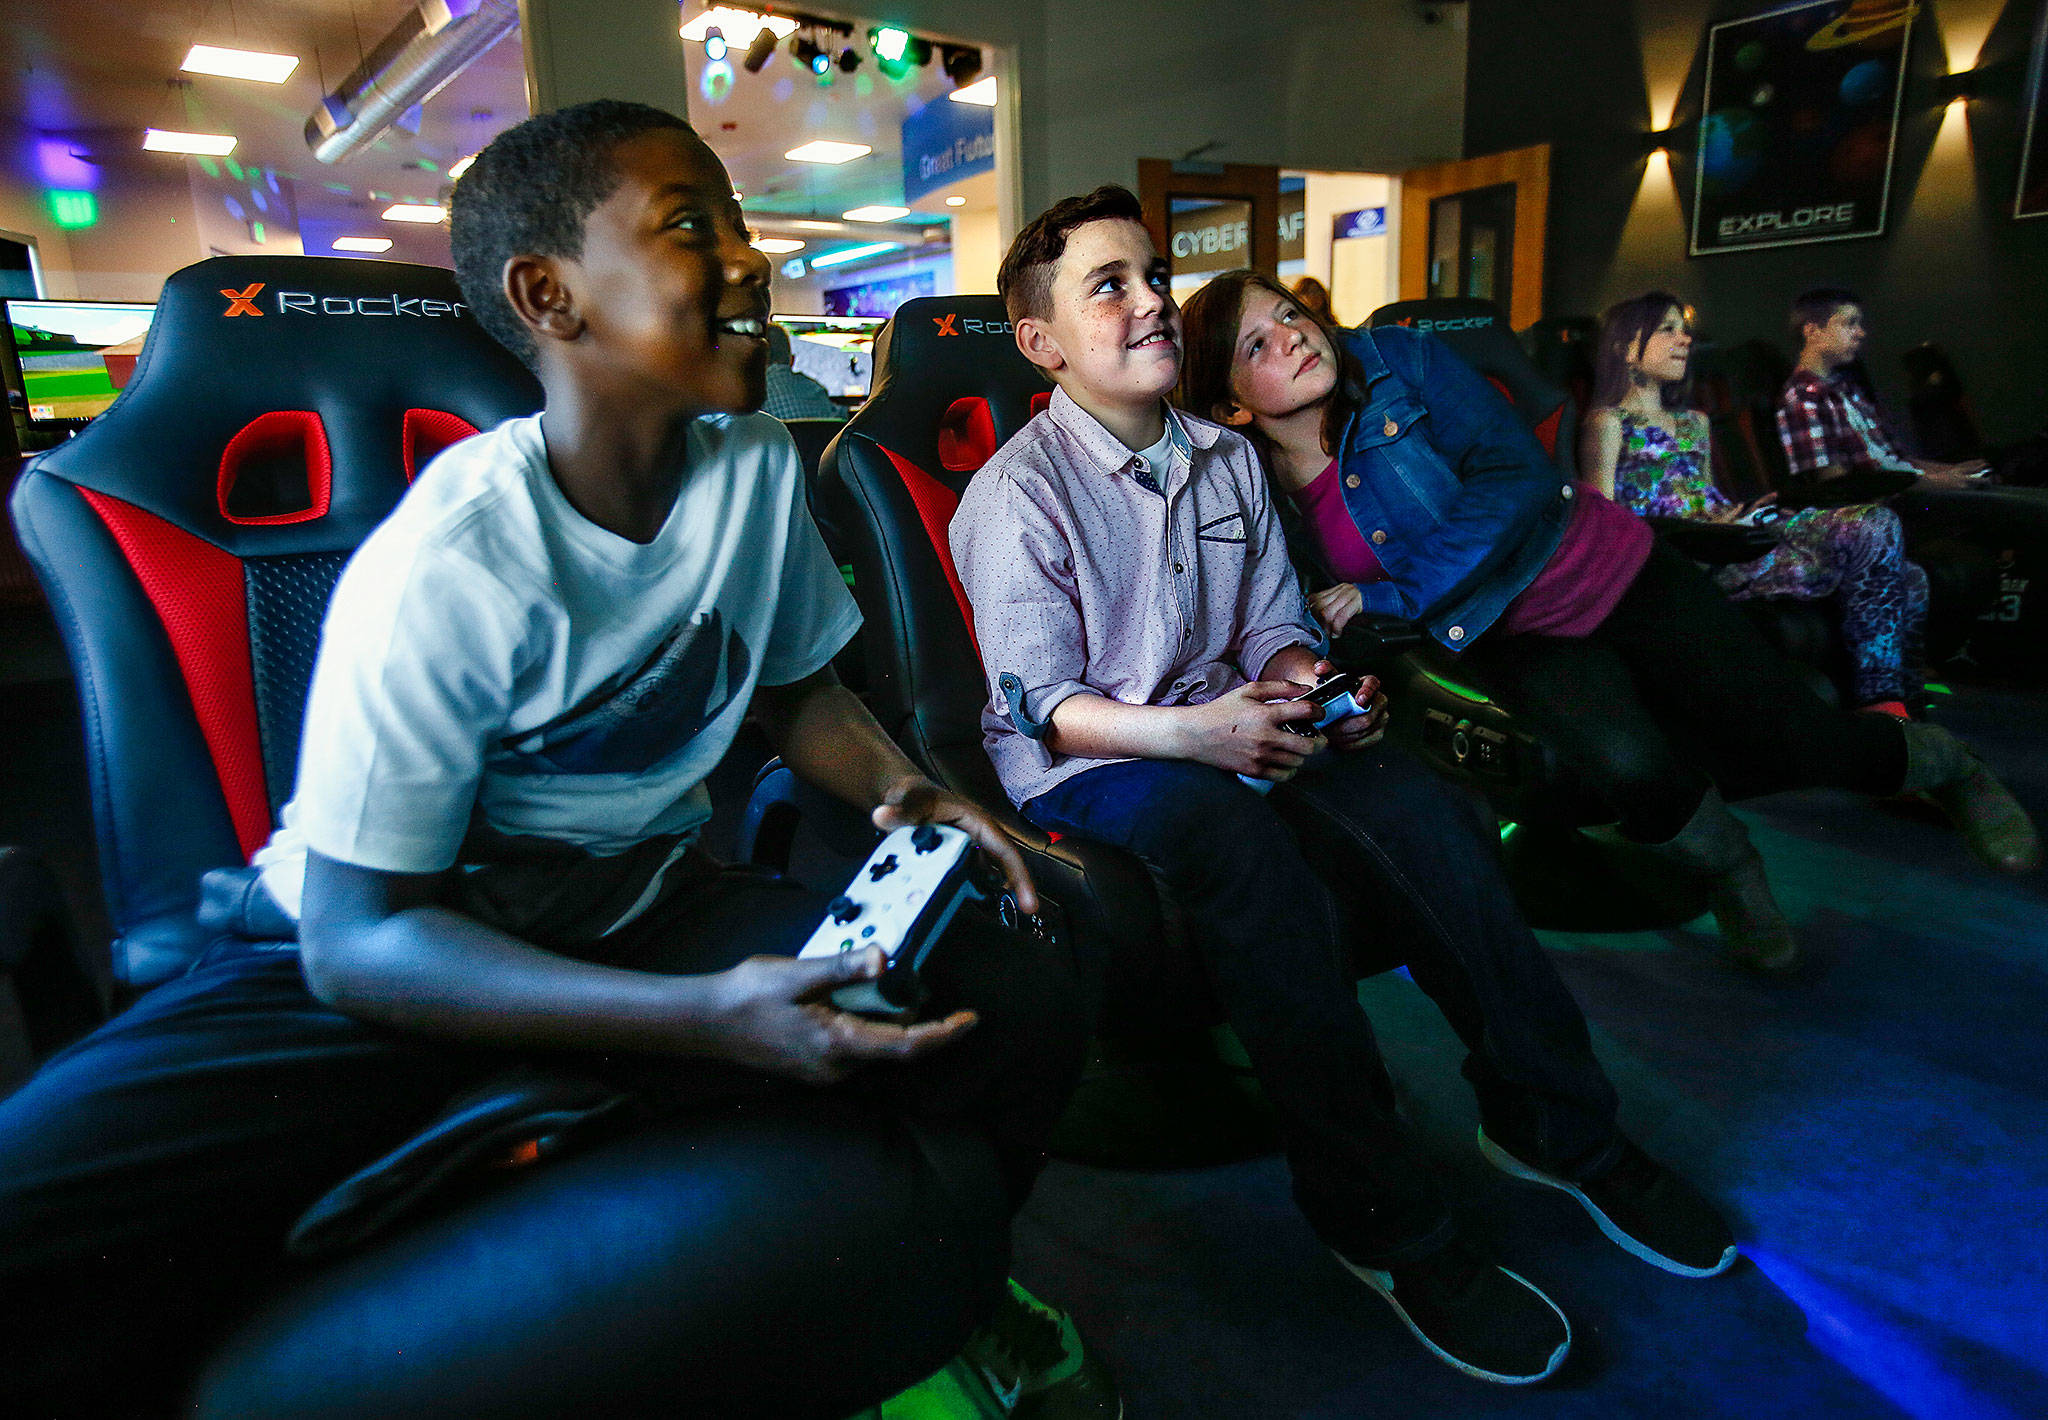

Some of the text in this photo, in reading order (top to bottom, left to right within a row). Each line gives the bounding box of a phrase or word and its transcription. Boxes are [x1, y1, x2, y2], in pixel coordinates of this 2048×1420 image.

[1719, 203, 1855, 235] EXPLORE
[1171, 220, 1249, 258] CYBER
[220, 283, 468, 318] X Rocker
[933, 314, 1014, 336] X Roc
